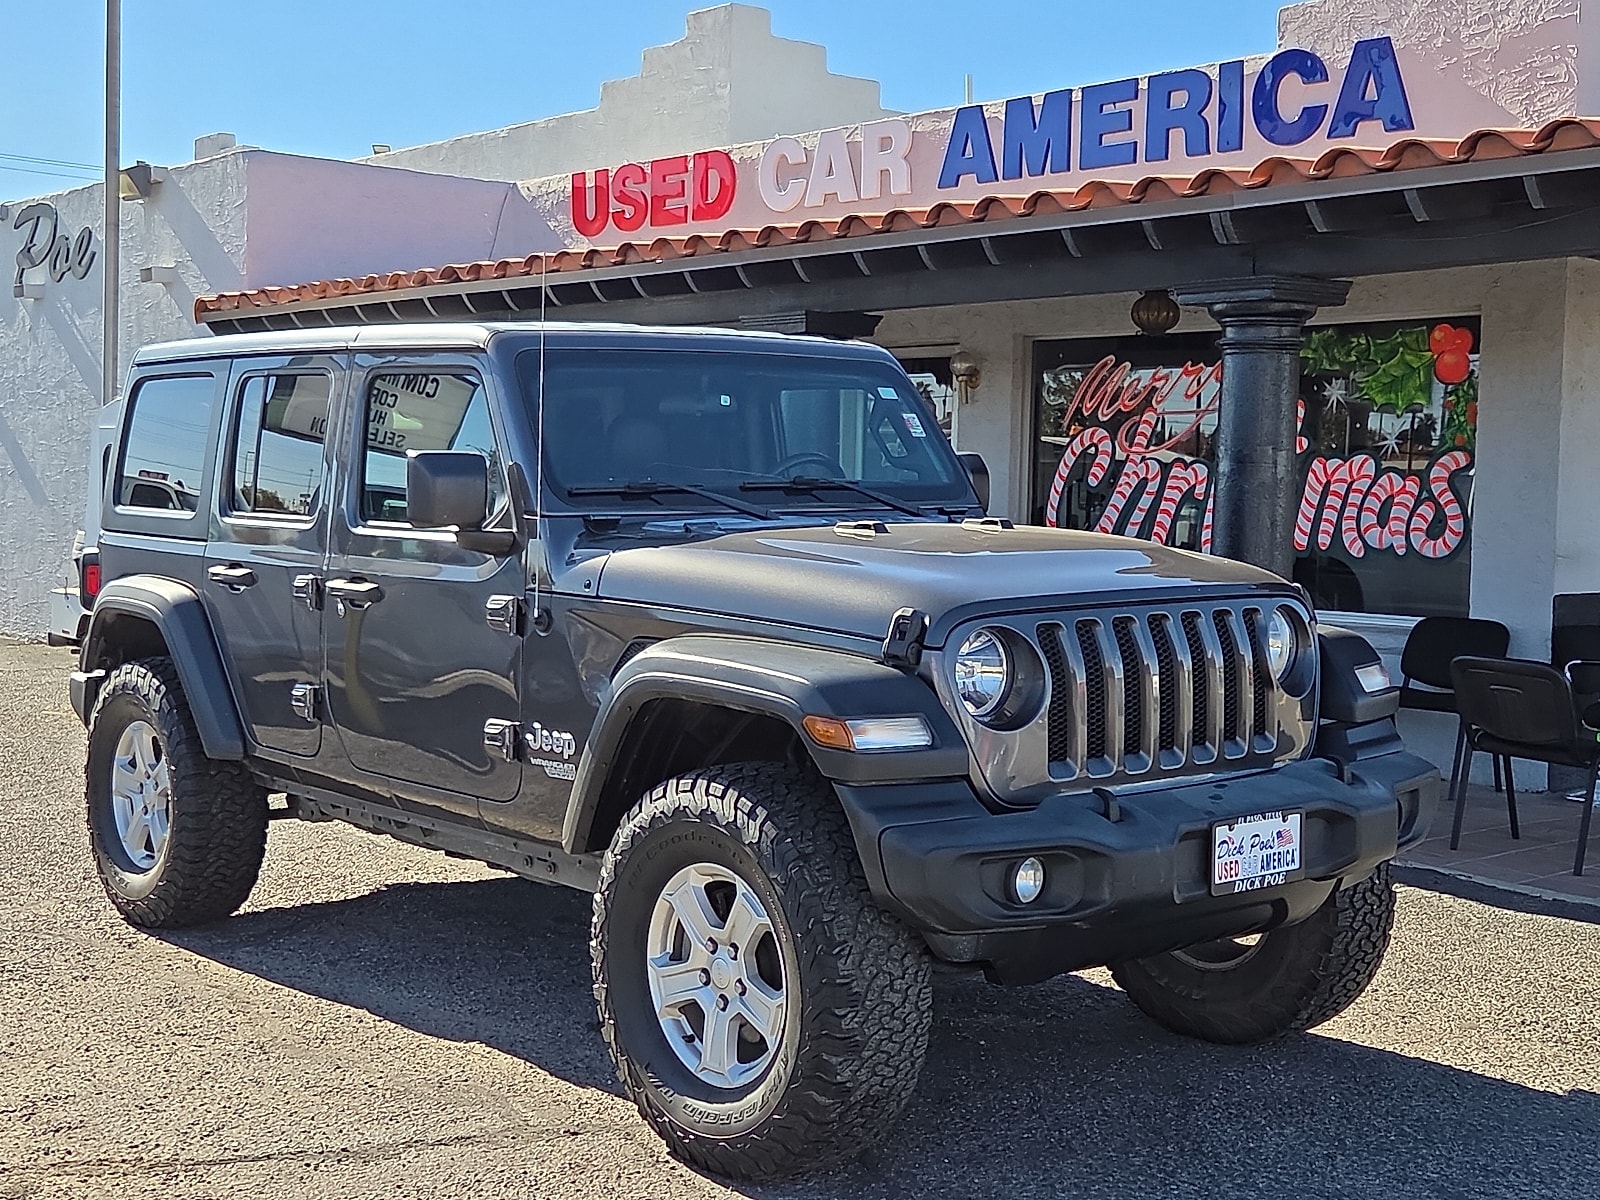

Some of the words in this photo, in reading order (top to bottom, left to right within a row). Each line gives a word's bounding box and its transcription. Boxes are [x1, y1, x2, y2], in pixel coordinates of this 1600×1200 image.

[571, 149, 736, 237] USED
[758, 119, 912, 213] CAR
[937, 36, 1415, 190] AMERICA
[13, 202, 97, 284] Poe
[524, 721, 576, 760] Jeep
[1217, 836, 1245, 860] Dick
[1249, 830, 1276, 855] Poe's
[1217, 859, 1240, 881] USED
[1260, 847, 1297, 873] AMERICA
[1233, 878, 1262, 893] DICK
[1263, 871, 1287, 888] POE
